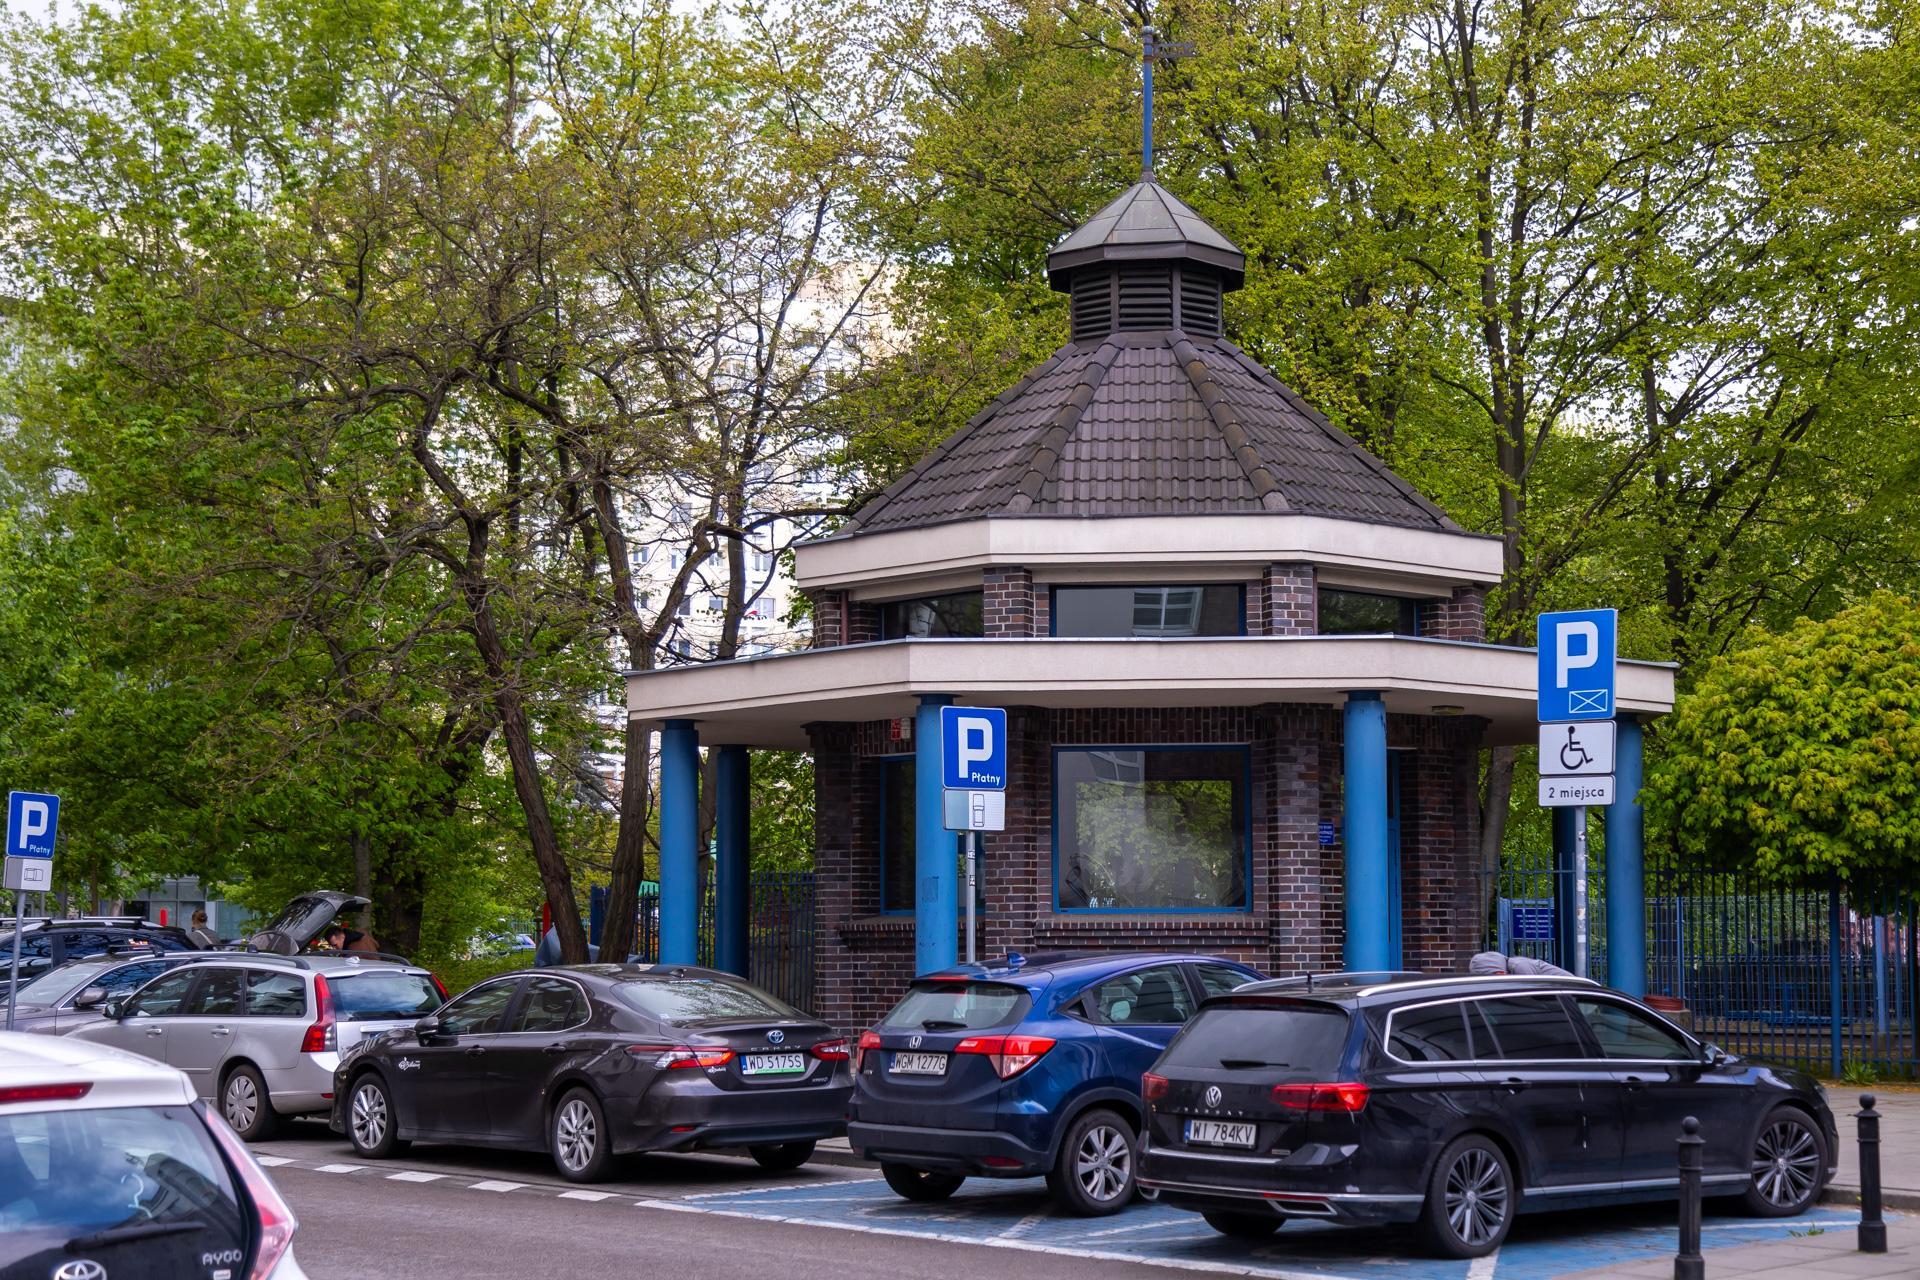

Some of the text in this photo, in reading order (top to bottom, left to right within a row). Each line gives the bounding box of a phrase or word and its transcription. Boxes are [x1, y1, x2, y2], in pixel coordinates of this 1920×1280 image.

[1556, 621, 1598, 688] P
[957, 717, 993, 778] P
[972, 772, 1000, 786] Płatny
[1549, 786, 1604, 800] 2 miejsca
[19, 800, 49, 849] P
[29, 844, 51, 856] Płatny
[749, 1054, 802, 1069] WD 5175S
[896, 1053, 946, 1070] WGM 1277G
[1193, 1121, 1253, 1143] WI 784KV
